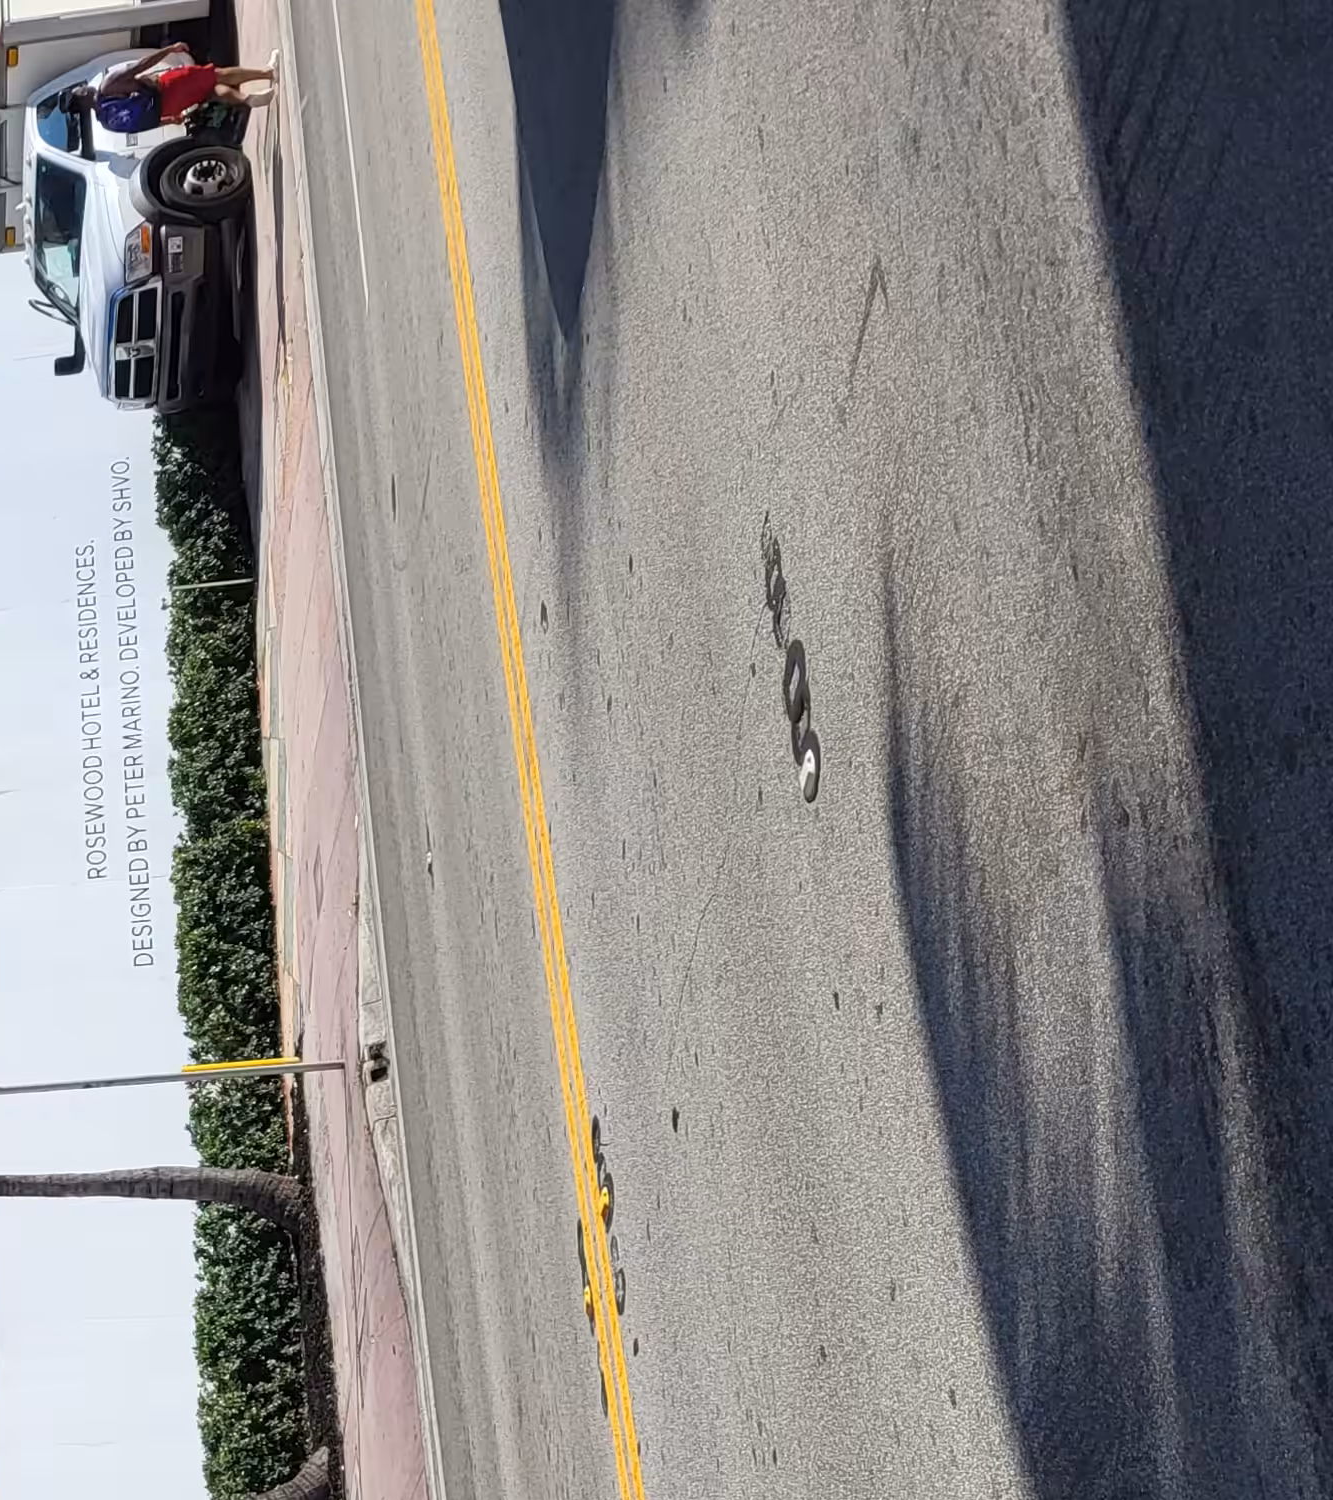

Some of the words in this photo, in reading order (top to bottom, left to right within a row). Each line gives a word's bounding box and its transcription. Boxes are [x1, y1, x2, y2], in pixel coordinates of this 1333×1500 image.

[110, 456, 132, 513] SHVO.
[112, 517, 133, 542] BY
[75, 539, 100, 664] RESIDENCES.
[114, 546, 139, 662] DEVELOPED
[79, 667, 100, 681] &
[119, 665, 143, 750] MARINO.
[80, 684, 102, 751] HOTEL
[82, 755, 108, 880] ROSEWOOD
[123, 753, 147, 820] PETER
[125, 825, 148, 853] BY
[128, 857, 155, 967] DESIGNED
